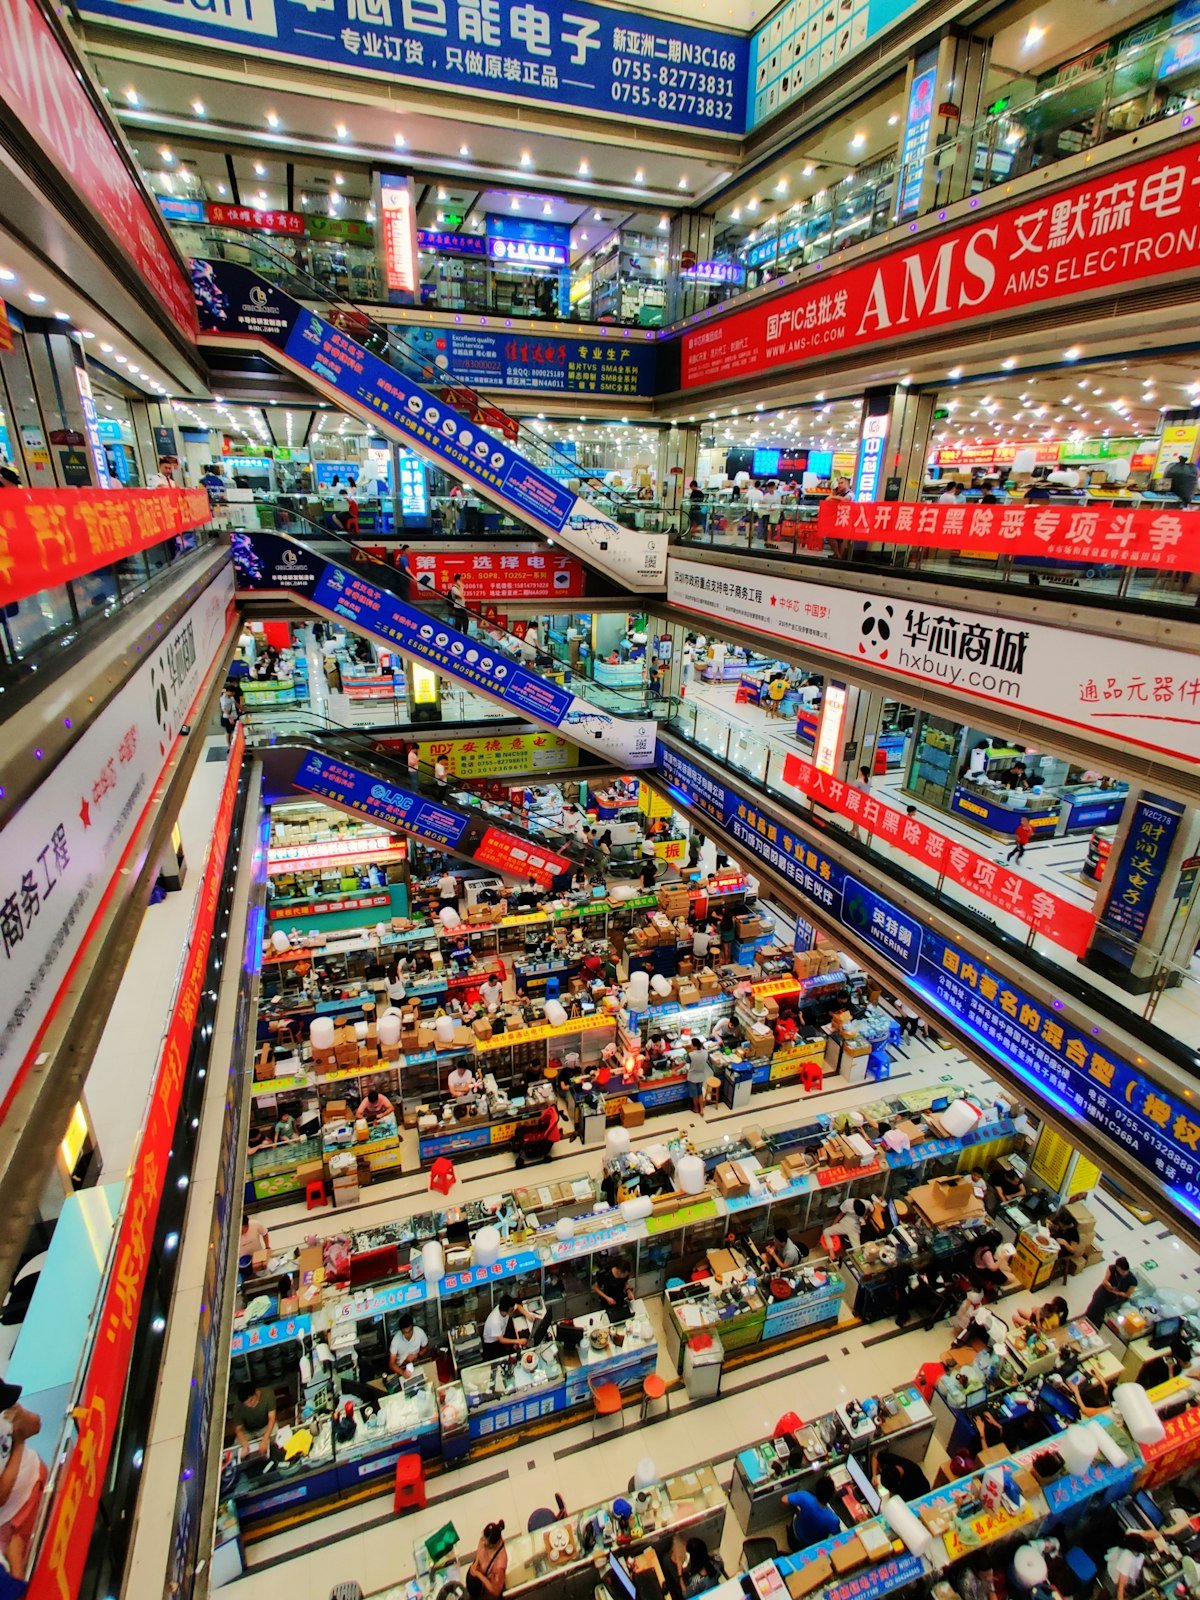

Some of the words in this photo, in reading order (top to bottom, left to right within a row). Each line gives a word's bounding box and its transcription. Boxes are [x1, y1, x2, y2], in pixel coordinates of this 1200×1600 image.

[293, 0, 601, 65] 芯巨能电子
[612, 26, 737, 72] 新亚洲二期N3C168
[611, 57, 735, 98] 0755-82773831
[610, 82, 734, 121] 0755-82773832
[1009, 154, 1200, 262] 艾默森电
[855, 224, 1001, 337] AMS
[1004, 262, 1051, 296] AMS
[1053, 224, 1200, 285] ELECTRON
[765, 288, 849, 342] 国产IC总批发
[452, 341, 465, 349] Best
[476, 336, 496, 345] quality
[577, 345, 632, 361] 专业生产
[765, 326, 846, 359] WWW.AMS-IC.COM
[834, 504, 1183, 551] 深入开展扫黑除恶专项斗争
[415, 555, 572, 570] 第一选择电子
[778, 595, 800, 613] 中华芯
[902, 609, 1031, 675] 华芯商城
[899, 648, 1021, 698] hxbuy.com
[1142, 806, 1173, 825] N2C278
[732, 820, 834, 907] 致力成为您的最佳合作伙伴
[782, 835, 832, 882] 专业服务
[797, 763, 1057, 922] 深入开展扫黑除恶专项斗争
[870, 925, 909, 960] INTERINE
